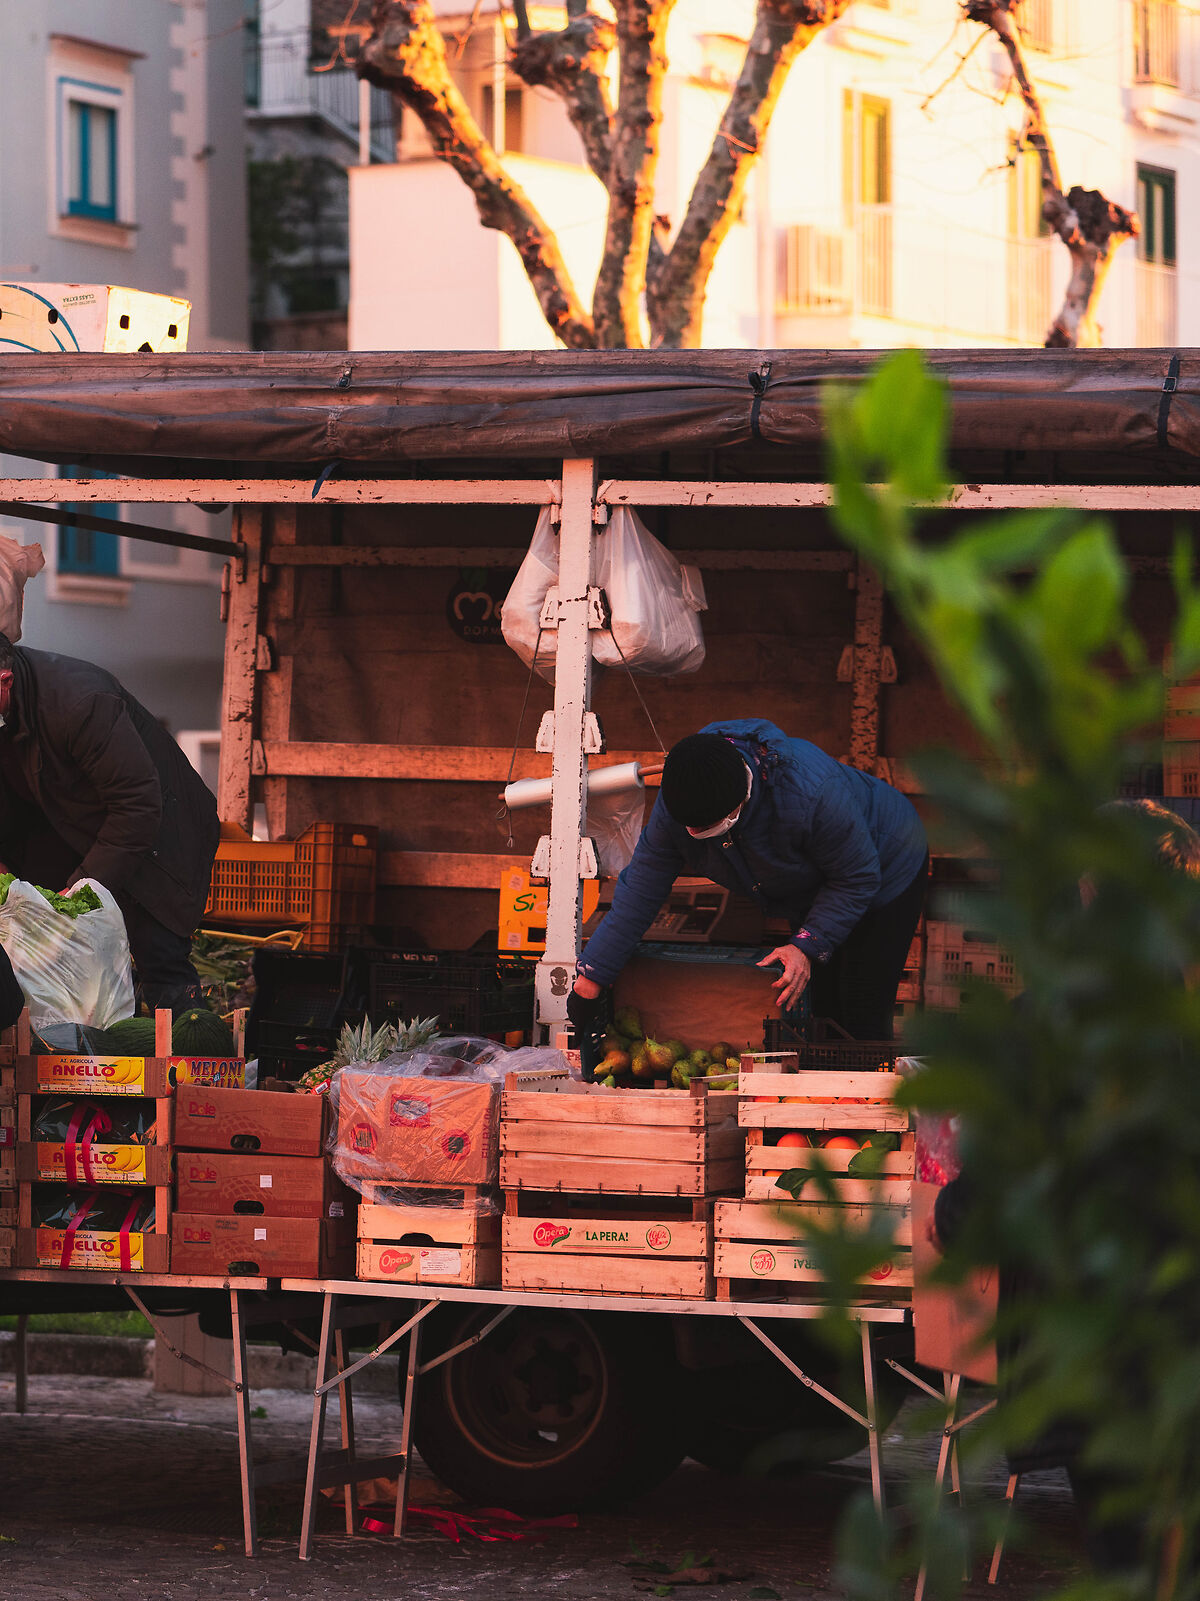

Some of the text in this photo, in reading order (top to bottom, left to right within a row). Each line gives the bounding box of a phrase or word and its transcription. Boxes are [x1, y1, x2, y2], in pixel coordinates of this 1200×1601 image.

[52, 1064, 116, 1078] ANELLO
[190, 1060, 242, 1078] MELONI
[188, 1100, 217, 1115] Dole
[189, 1166, 217, 1180] Dole
[183, 1227, 212, 1241] Dole
[535, 1226, 565, 1240] Opera
[586, 1231, 629, 1242] LA PERA!
[51, 1239, 115, 1253] AELLO
[381, 1254, 408, 1267] Opera
